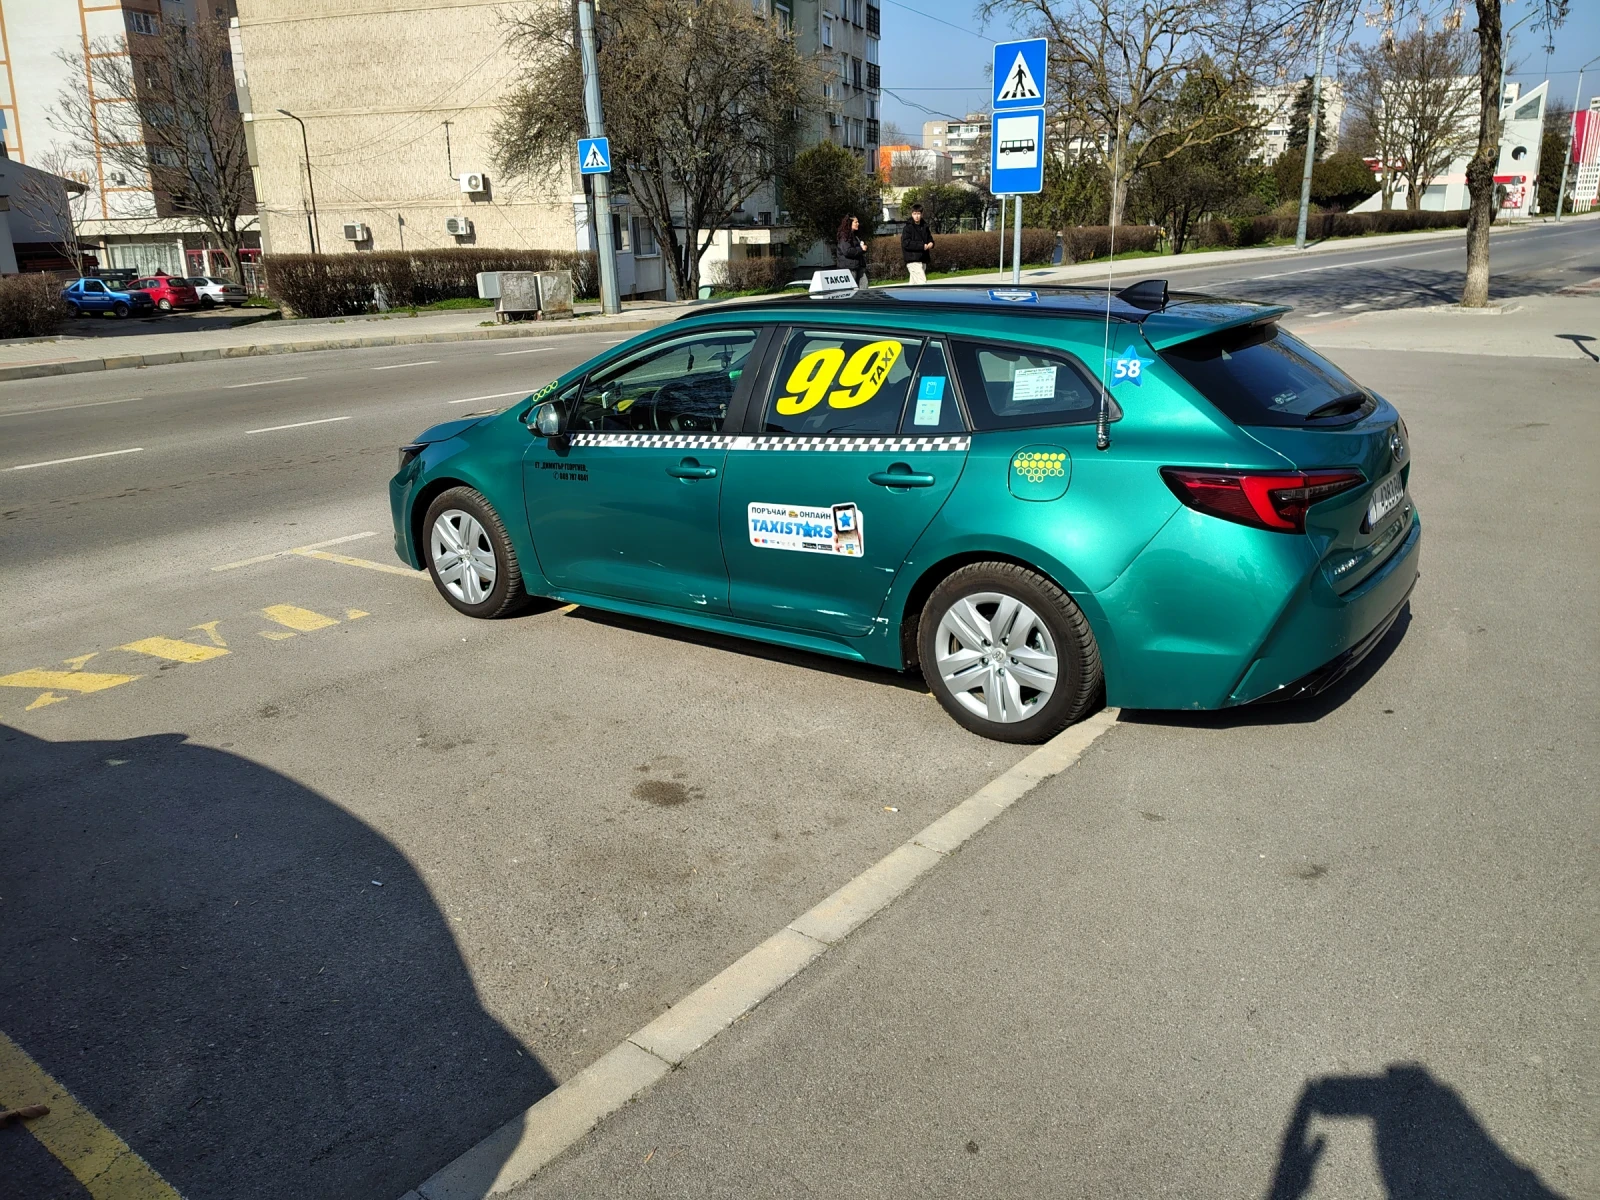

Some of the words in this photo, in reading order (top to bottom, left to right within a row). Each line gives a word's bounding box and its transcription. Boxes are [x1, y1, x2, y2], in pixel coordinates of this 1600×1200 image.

[824, 275, 851, 285] ТАКСИ
[869, 346, 895, 387] TAXI
[1114, 360, 1141, 378] 58
[775, 340, 903, 416] 99
[751, 506, 787, 517] ПОРЪЧАЙ
[799, 511, 832, 520] ОНЛАЙН
